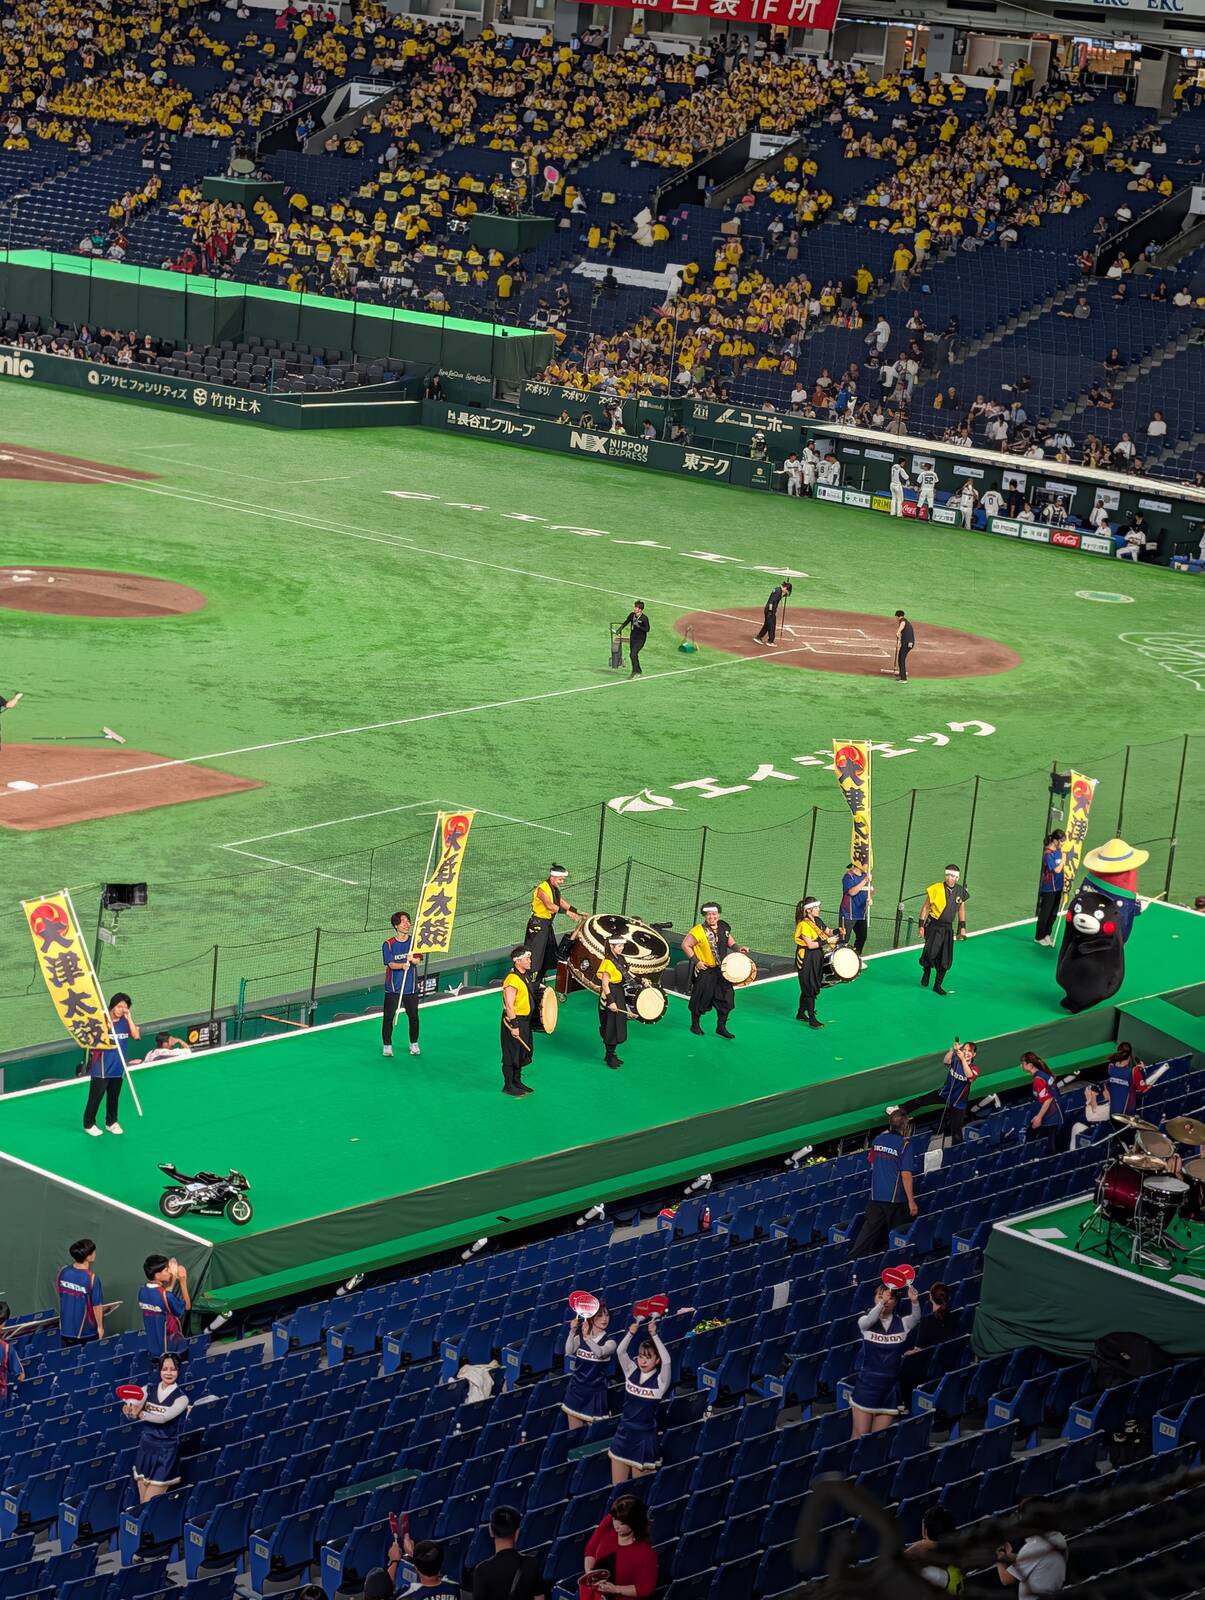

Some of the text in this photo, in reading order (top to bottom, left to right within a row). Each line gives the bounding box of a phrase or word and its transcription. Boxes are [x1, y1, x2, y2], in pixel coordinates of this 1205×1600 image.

[631, 0, 821, 24] 製作所
[210, 391, 262, 415] 竹中土木
[457, 411, 536, 438] 長谷工グループ
[740, 412, 794, 433] ユニホー
[608, 447, 648, 463] EXPRESS
[609, 438, 649, 454] NIPPON
[682, 452, 730, 477] 東テク
[870, 1333, 904, 1343] HONDA
[627, 1384, 655, 1397] HONDA
